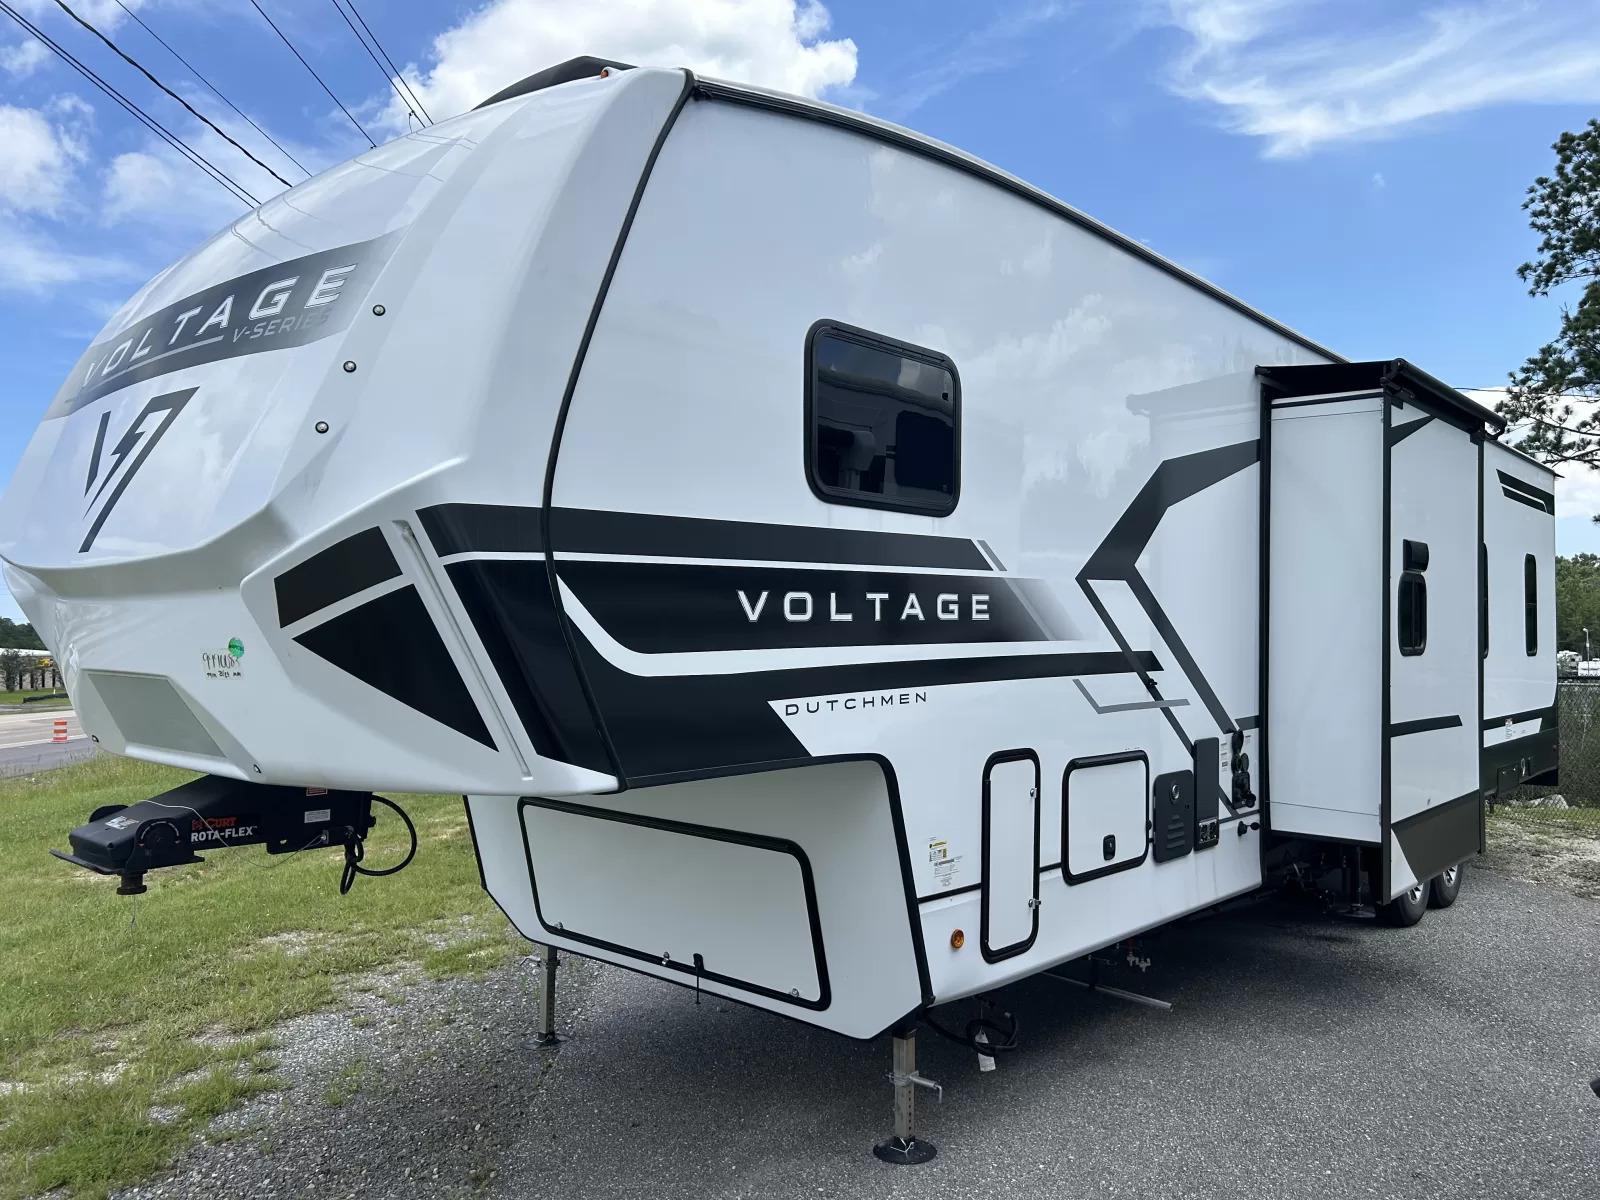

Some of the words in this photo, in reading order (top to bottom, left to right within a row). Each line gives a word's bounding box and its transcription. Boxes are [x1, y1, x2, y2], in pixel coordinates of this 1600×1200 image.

[82, 262, 358, 388] VOLTAGE
[232, 308, 332, 343] V-SERIES
[736, 589, 991, 622] VOLTAGE
[785, 691, 928, 717] DUTCHMEN
[205, 816, 236, 829] CURT
